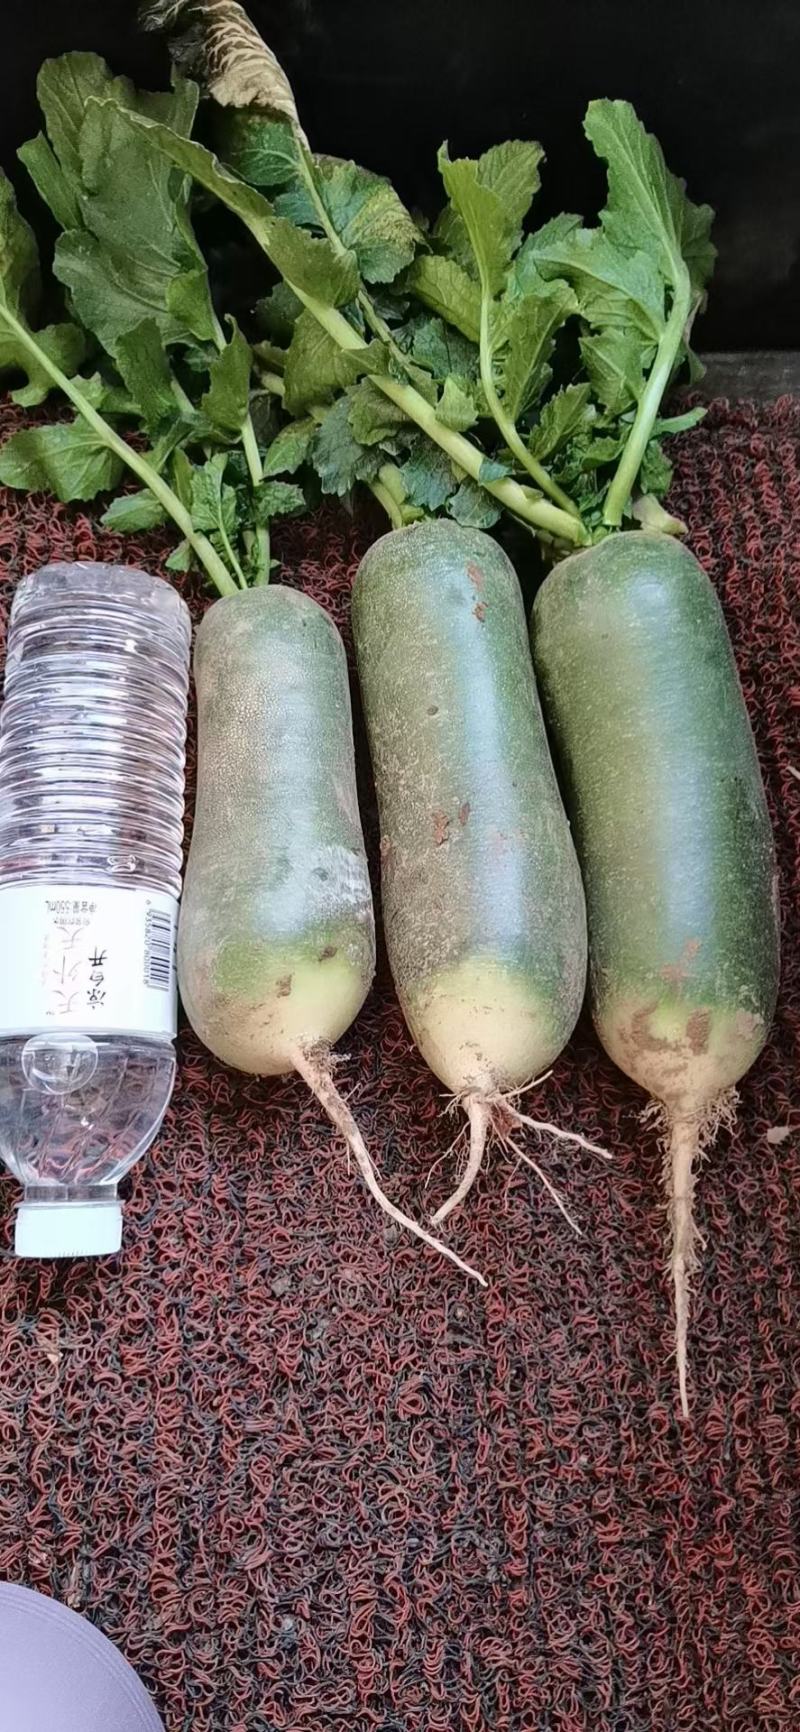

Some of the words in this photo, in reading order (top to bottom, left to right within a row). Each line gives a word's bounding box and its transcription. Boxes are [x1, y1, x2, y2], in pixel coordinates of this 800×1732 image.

[53, 926, 85, 1014] 天外天
[87, 946, 108, 1010] 凉白开
